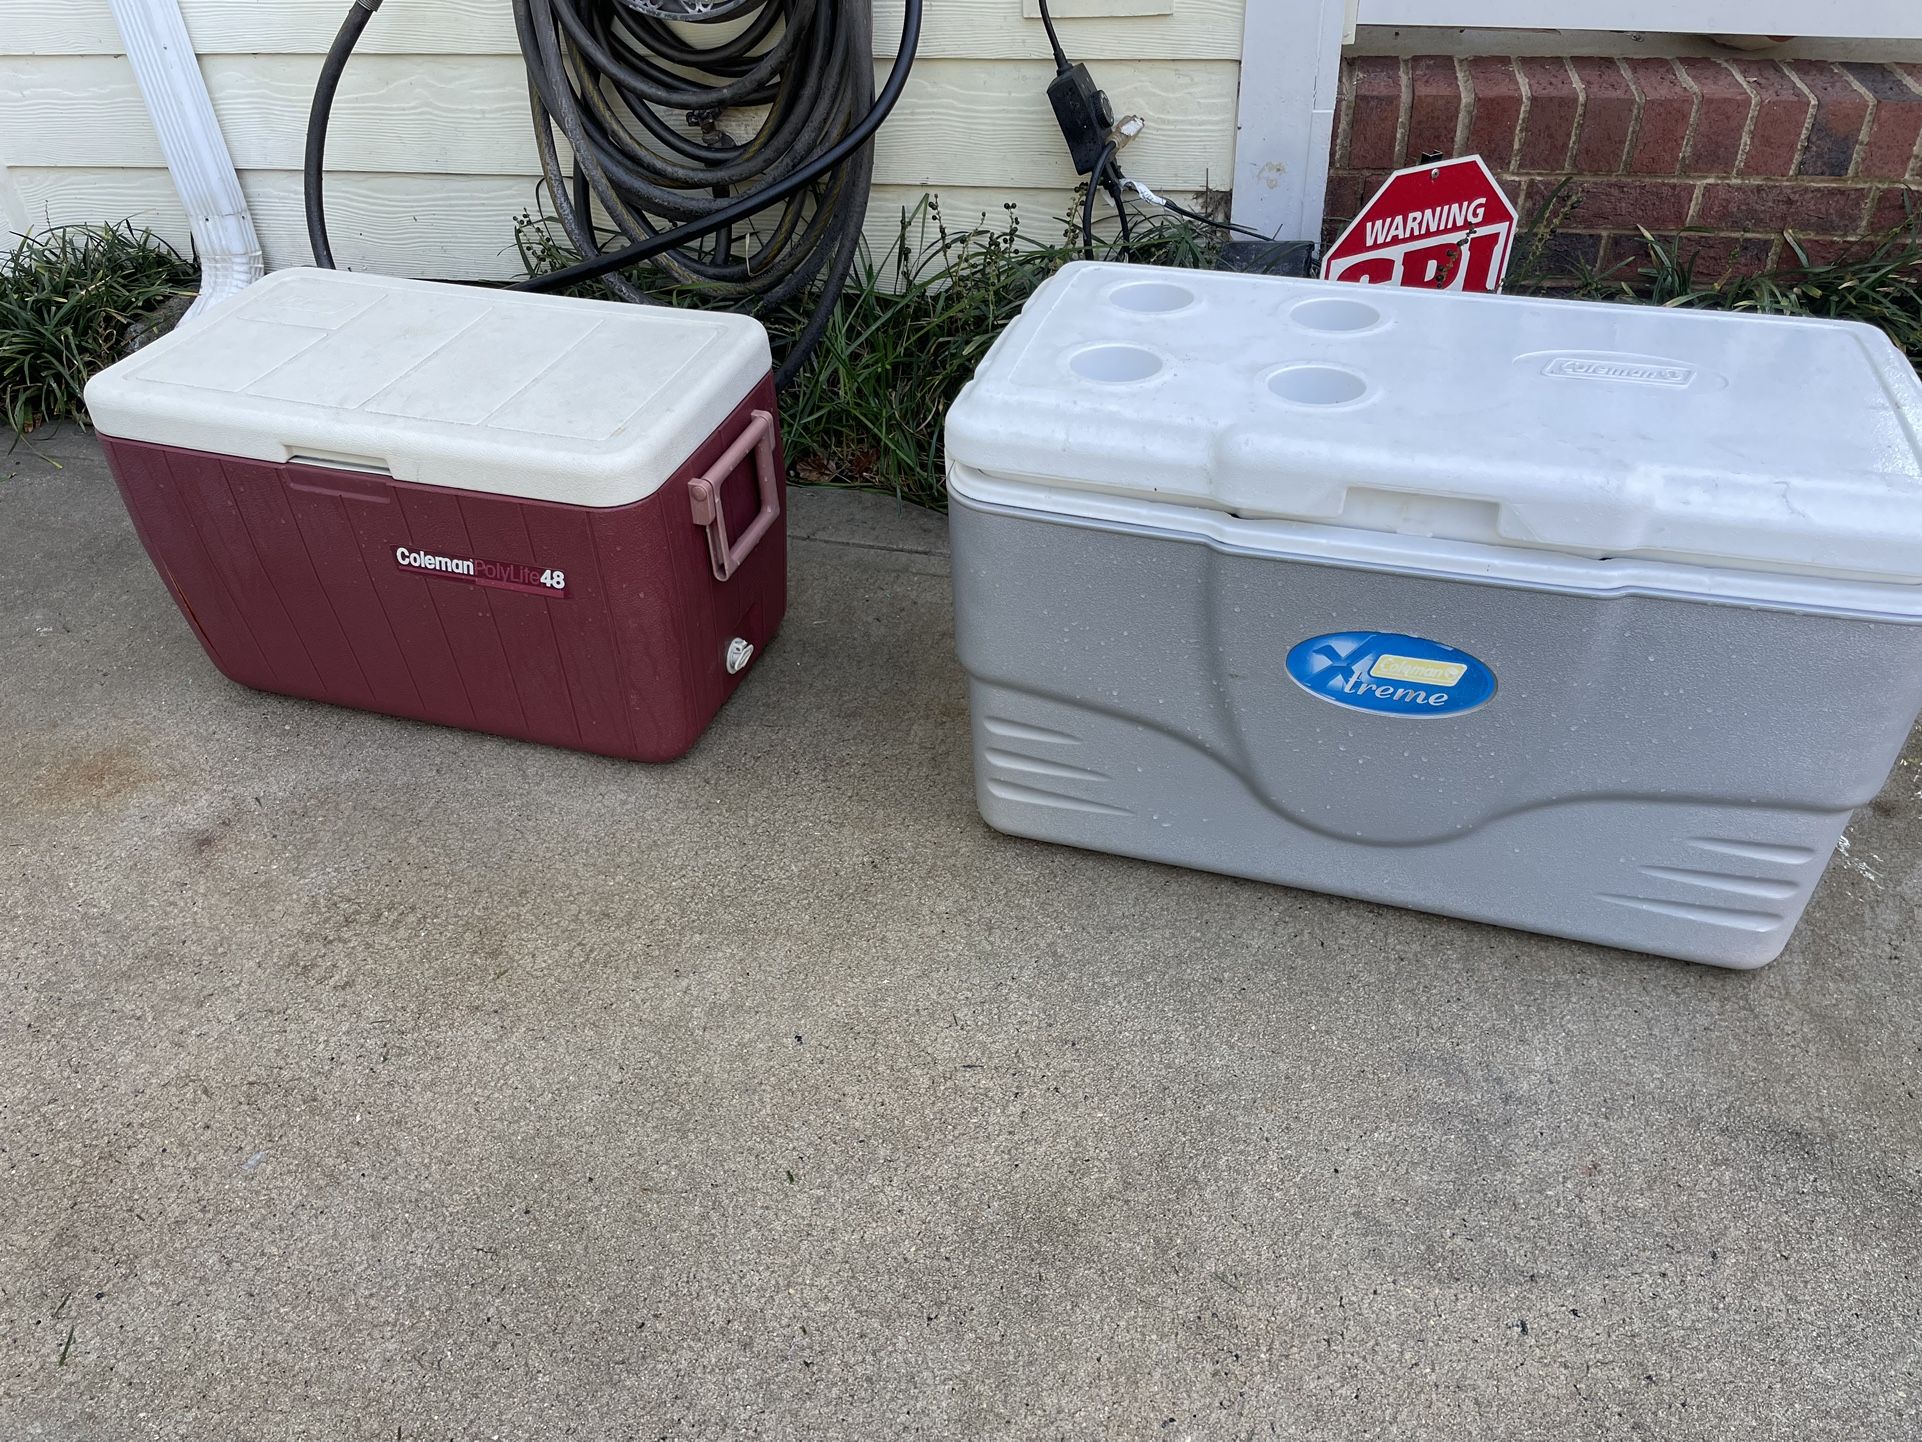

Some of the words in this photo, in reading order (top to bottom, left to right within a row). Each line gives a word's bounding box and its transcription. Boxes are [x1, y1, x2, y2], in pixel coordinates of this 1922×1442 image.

[1365, 197, 1487, 247] WARNING
[396, 547, 475, 576] Coleman
[474, 559, 541, 585] PolyLite
[539, 568, 566, 590] 48
